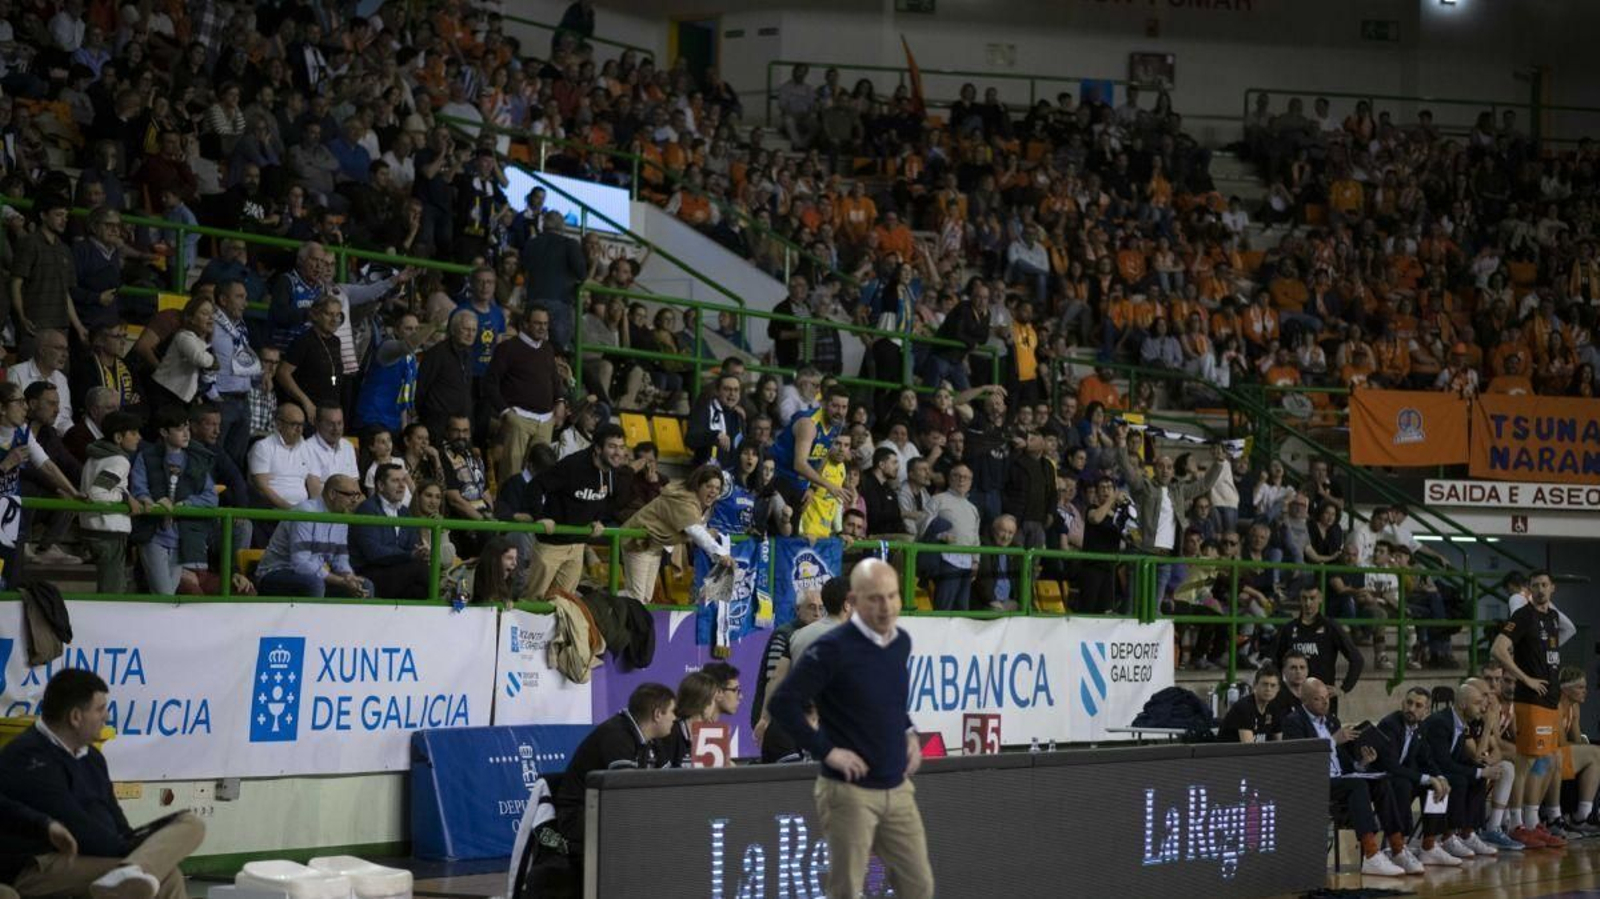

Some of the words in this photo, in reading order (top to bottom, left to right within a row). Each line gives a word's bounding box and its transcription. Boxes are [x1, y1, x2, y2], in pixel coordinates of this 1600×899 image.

[1429, 484, 1501, 503] SAIDA
[1509, 486, 1519, 504] E
[317, 647, 419, 683] XUNTA
[1110, 642, 1160, 660] DEPORTE
[915, 653, 1055, 712] ABANCA
[1110, 664, 1153, 682] GALEGO
[105, 698, 212, 736] ALICIA
[311, 695, 353, 731] DE
[361, 694, 469, 731] GALICIA
[695, 727, 726, 768] 5
